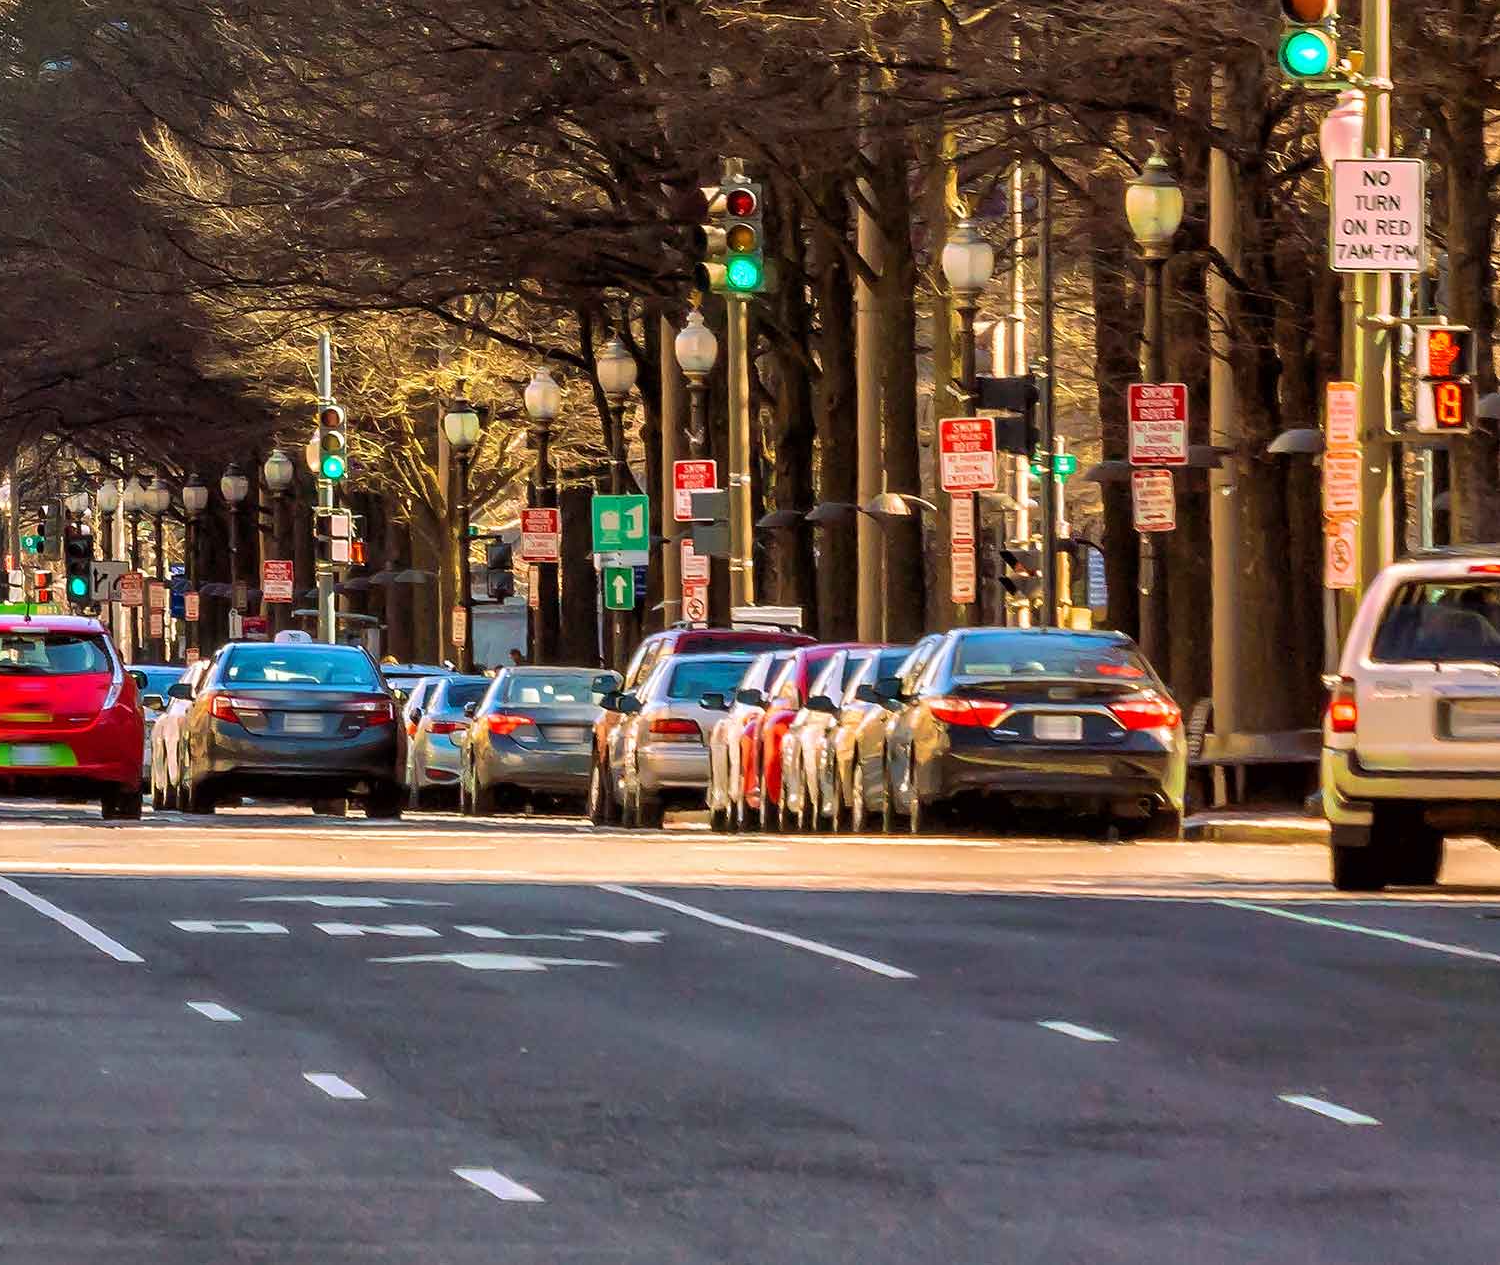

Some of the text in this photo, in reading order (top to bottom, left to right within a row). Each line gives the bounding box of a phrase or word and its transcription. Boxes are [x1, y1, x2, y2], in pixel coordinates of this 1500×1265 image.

[1362, 169, 1391, 187] NO
[1354, 194, 1401, 211] TURN
[1342, 218, 1411, 236] ON RED
[1335, 243, 1418, 260] 7AM-7PM
[1141, 386, 1174, 399] SNOW
[1140, 407, 1176, 420] ROUTE
[952, 423, 981, 433] SNOW
[952, 441, 985, 452] ROUTE
[683, 464, 707, 474] SNOW
[169, 918, 667, 944] ONLY
